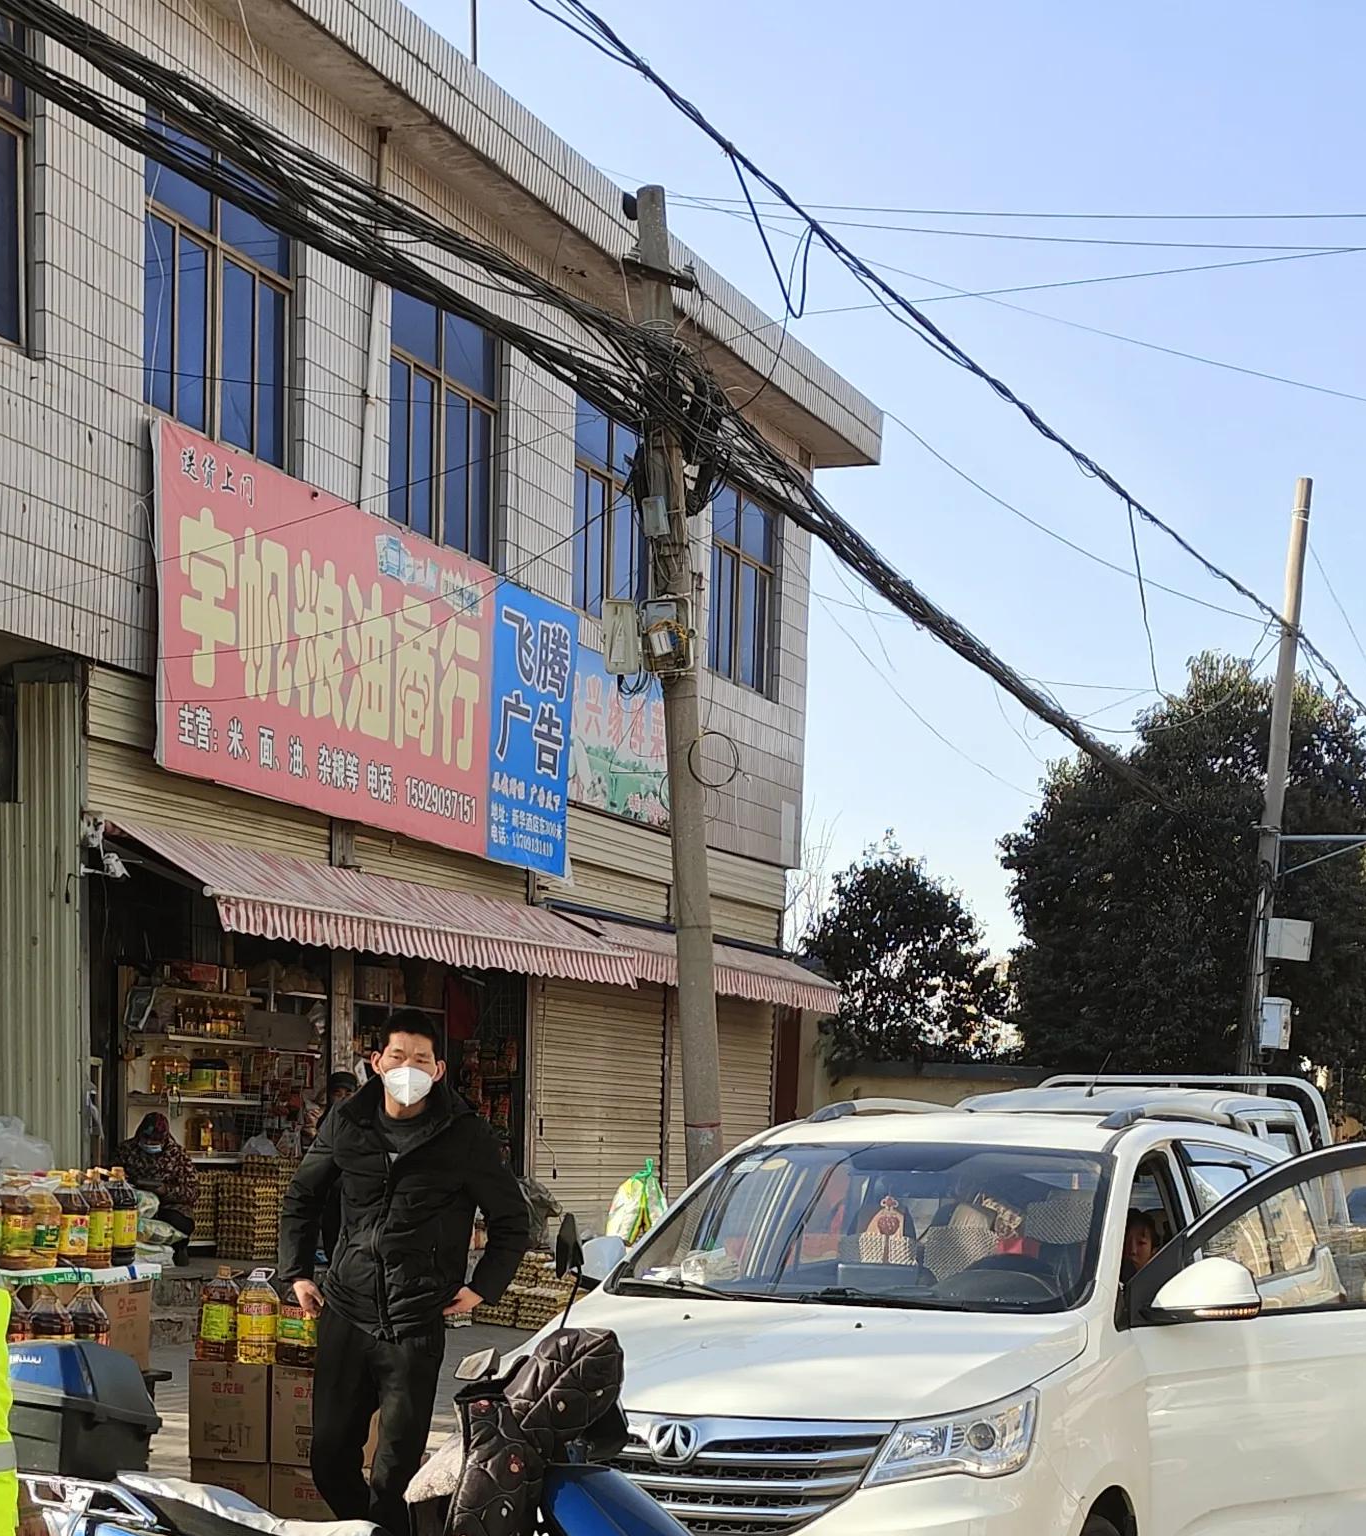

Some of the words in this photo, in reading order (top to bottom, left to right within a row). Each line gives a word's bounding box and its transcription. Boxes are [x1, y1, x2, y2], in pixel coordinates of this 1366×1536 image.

[180, 446, 255, 507] 送货上门
[178, 506, 482, 773] 宇帆粮油商行
[502, 606, 571, 704] 飞腾
[495, 690, 565, 780] 广告
